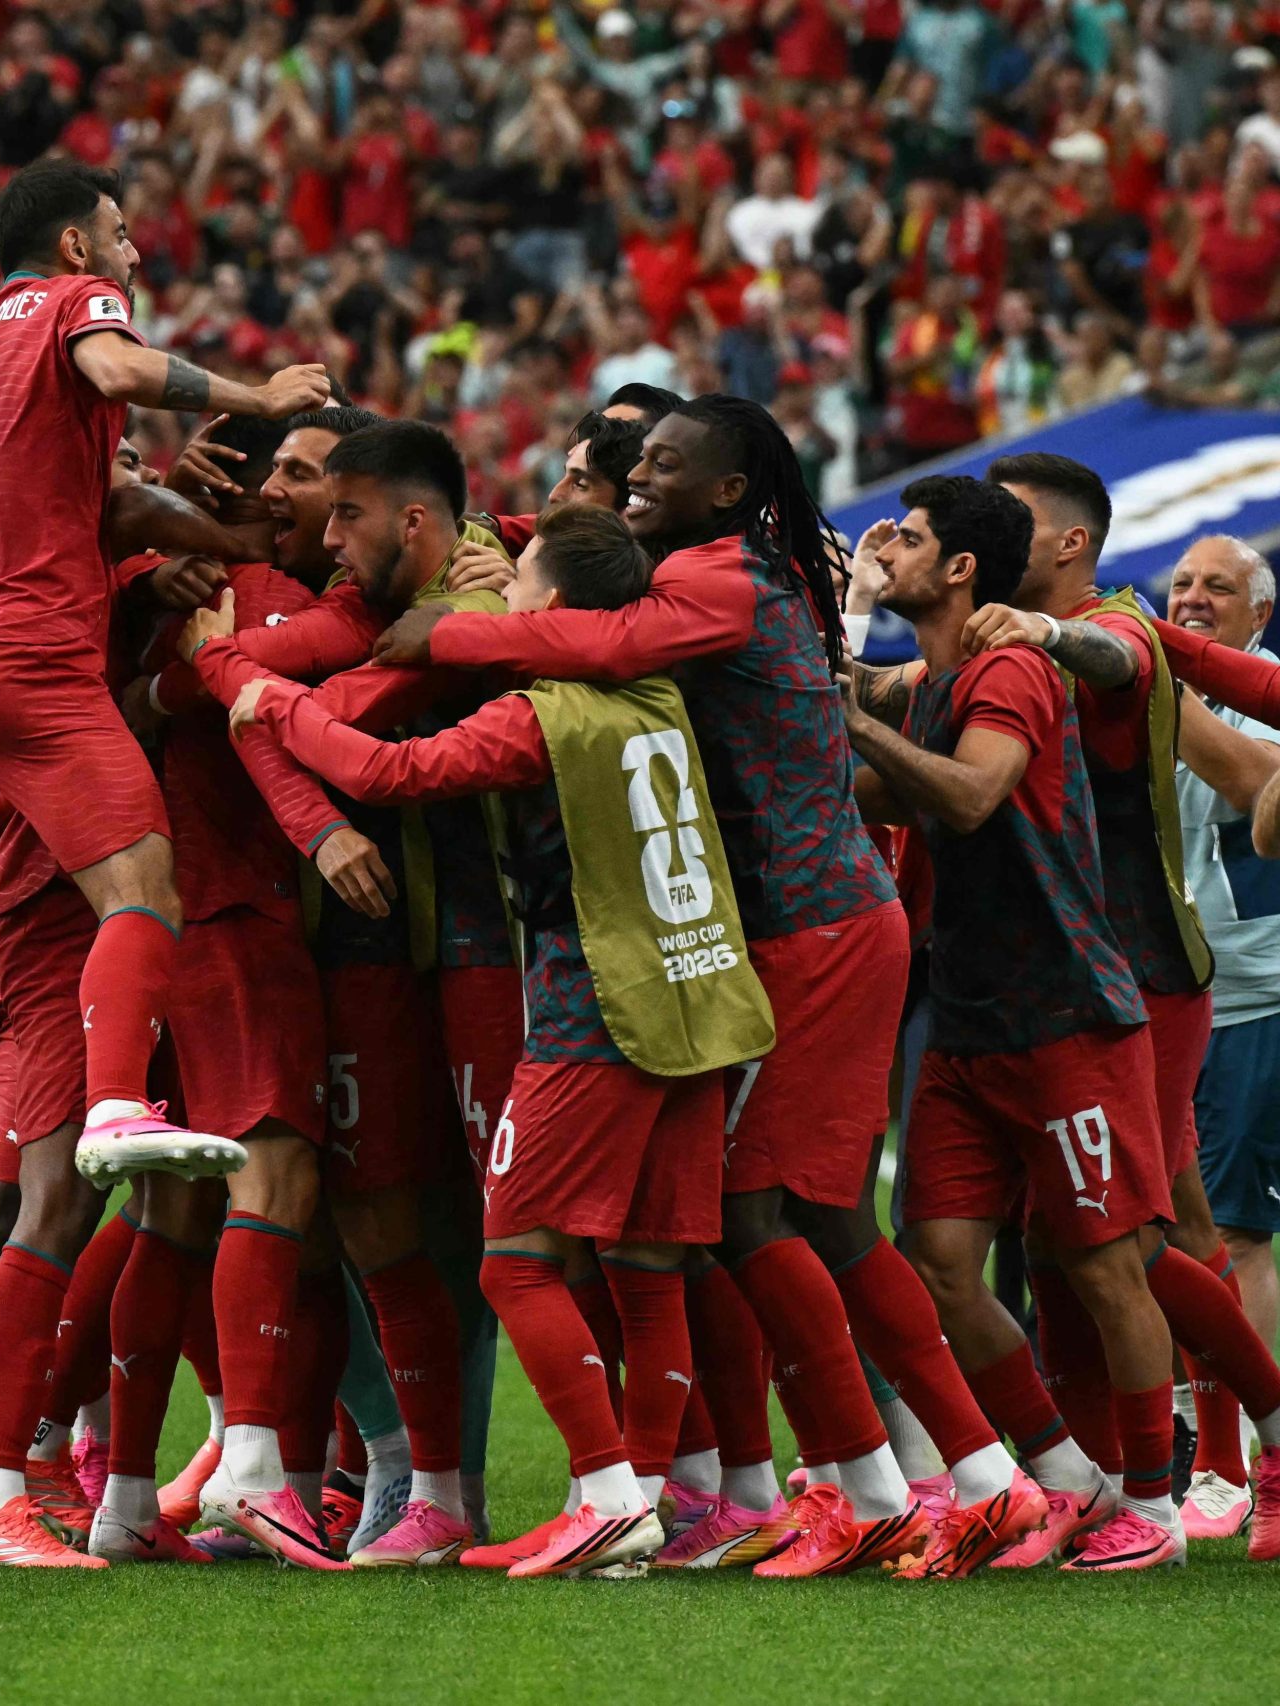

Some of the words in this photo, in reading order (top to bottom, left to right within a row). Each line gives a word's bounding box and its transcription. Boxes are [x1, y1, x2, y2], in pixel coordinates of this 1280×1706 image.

[669, 883, 697, 906] FIFA
[699, 923, 725, 943] CUP
[663, 943, 738, 983] 2026
[451, 1063, 488, 1139] 4
[488, 1099, 515, 1175] 6
[1046, 1104, 1112, 1191] 19
